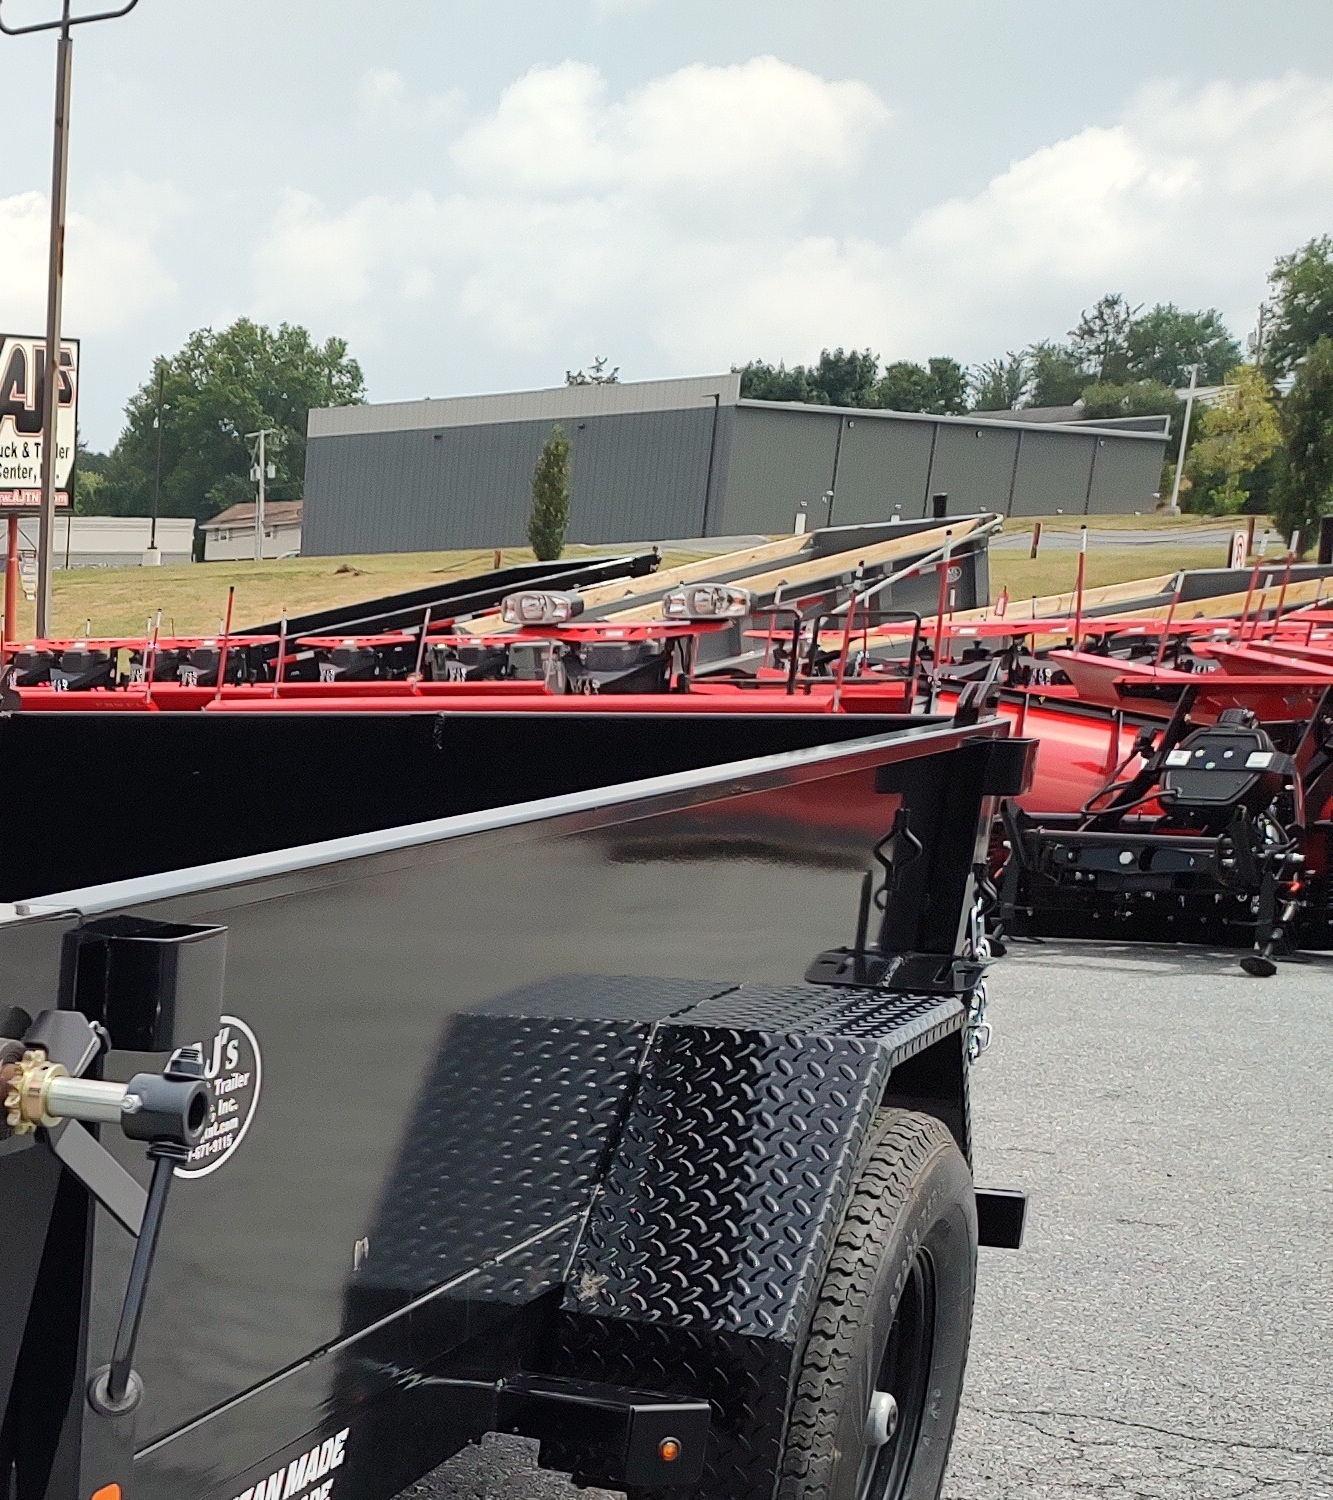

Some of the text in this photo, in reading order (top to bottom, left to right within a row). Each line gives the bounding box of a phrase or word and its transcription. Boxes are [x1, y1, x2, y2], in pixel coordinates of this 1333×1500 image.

[22, 442, 30, 458] &
[34, 443, 70, 459] Tler
[214, 1072, 250, 1096] Trailer
[283, 1427, 350, 1500] MADE
